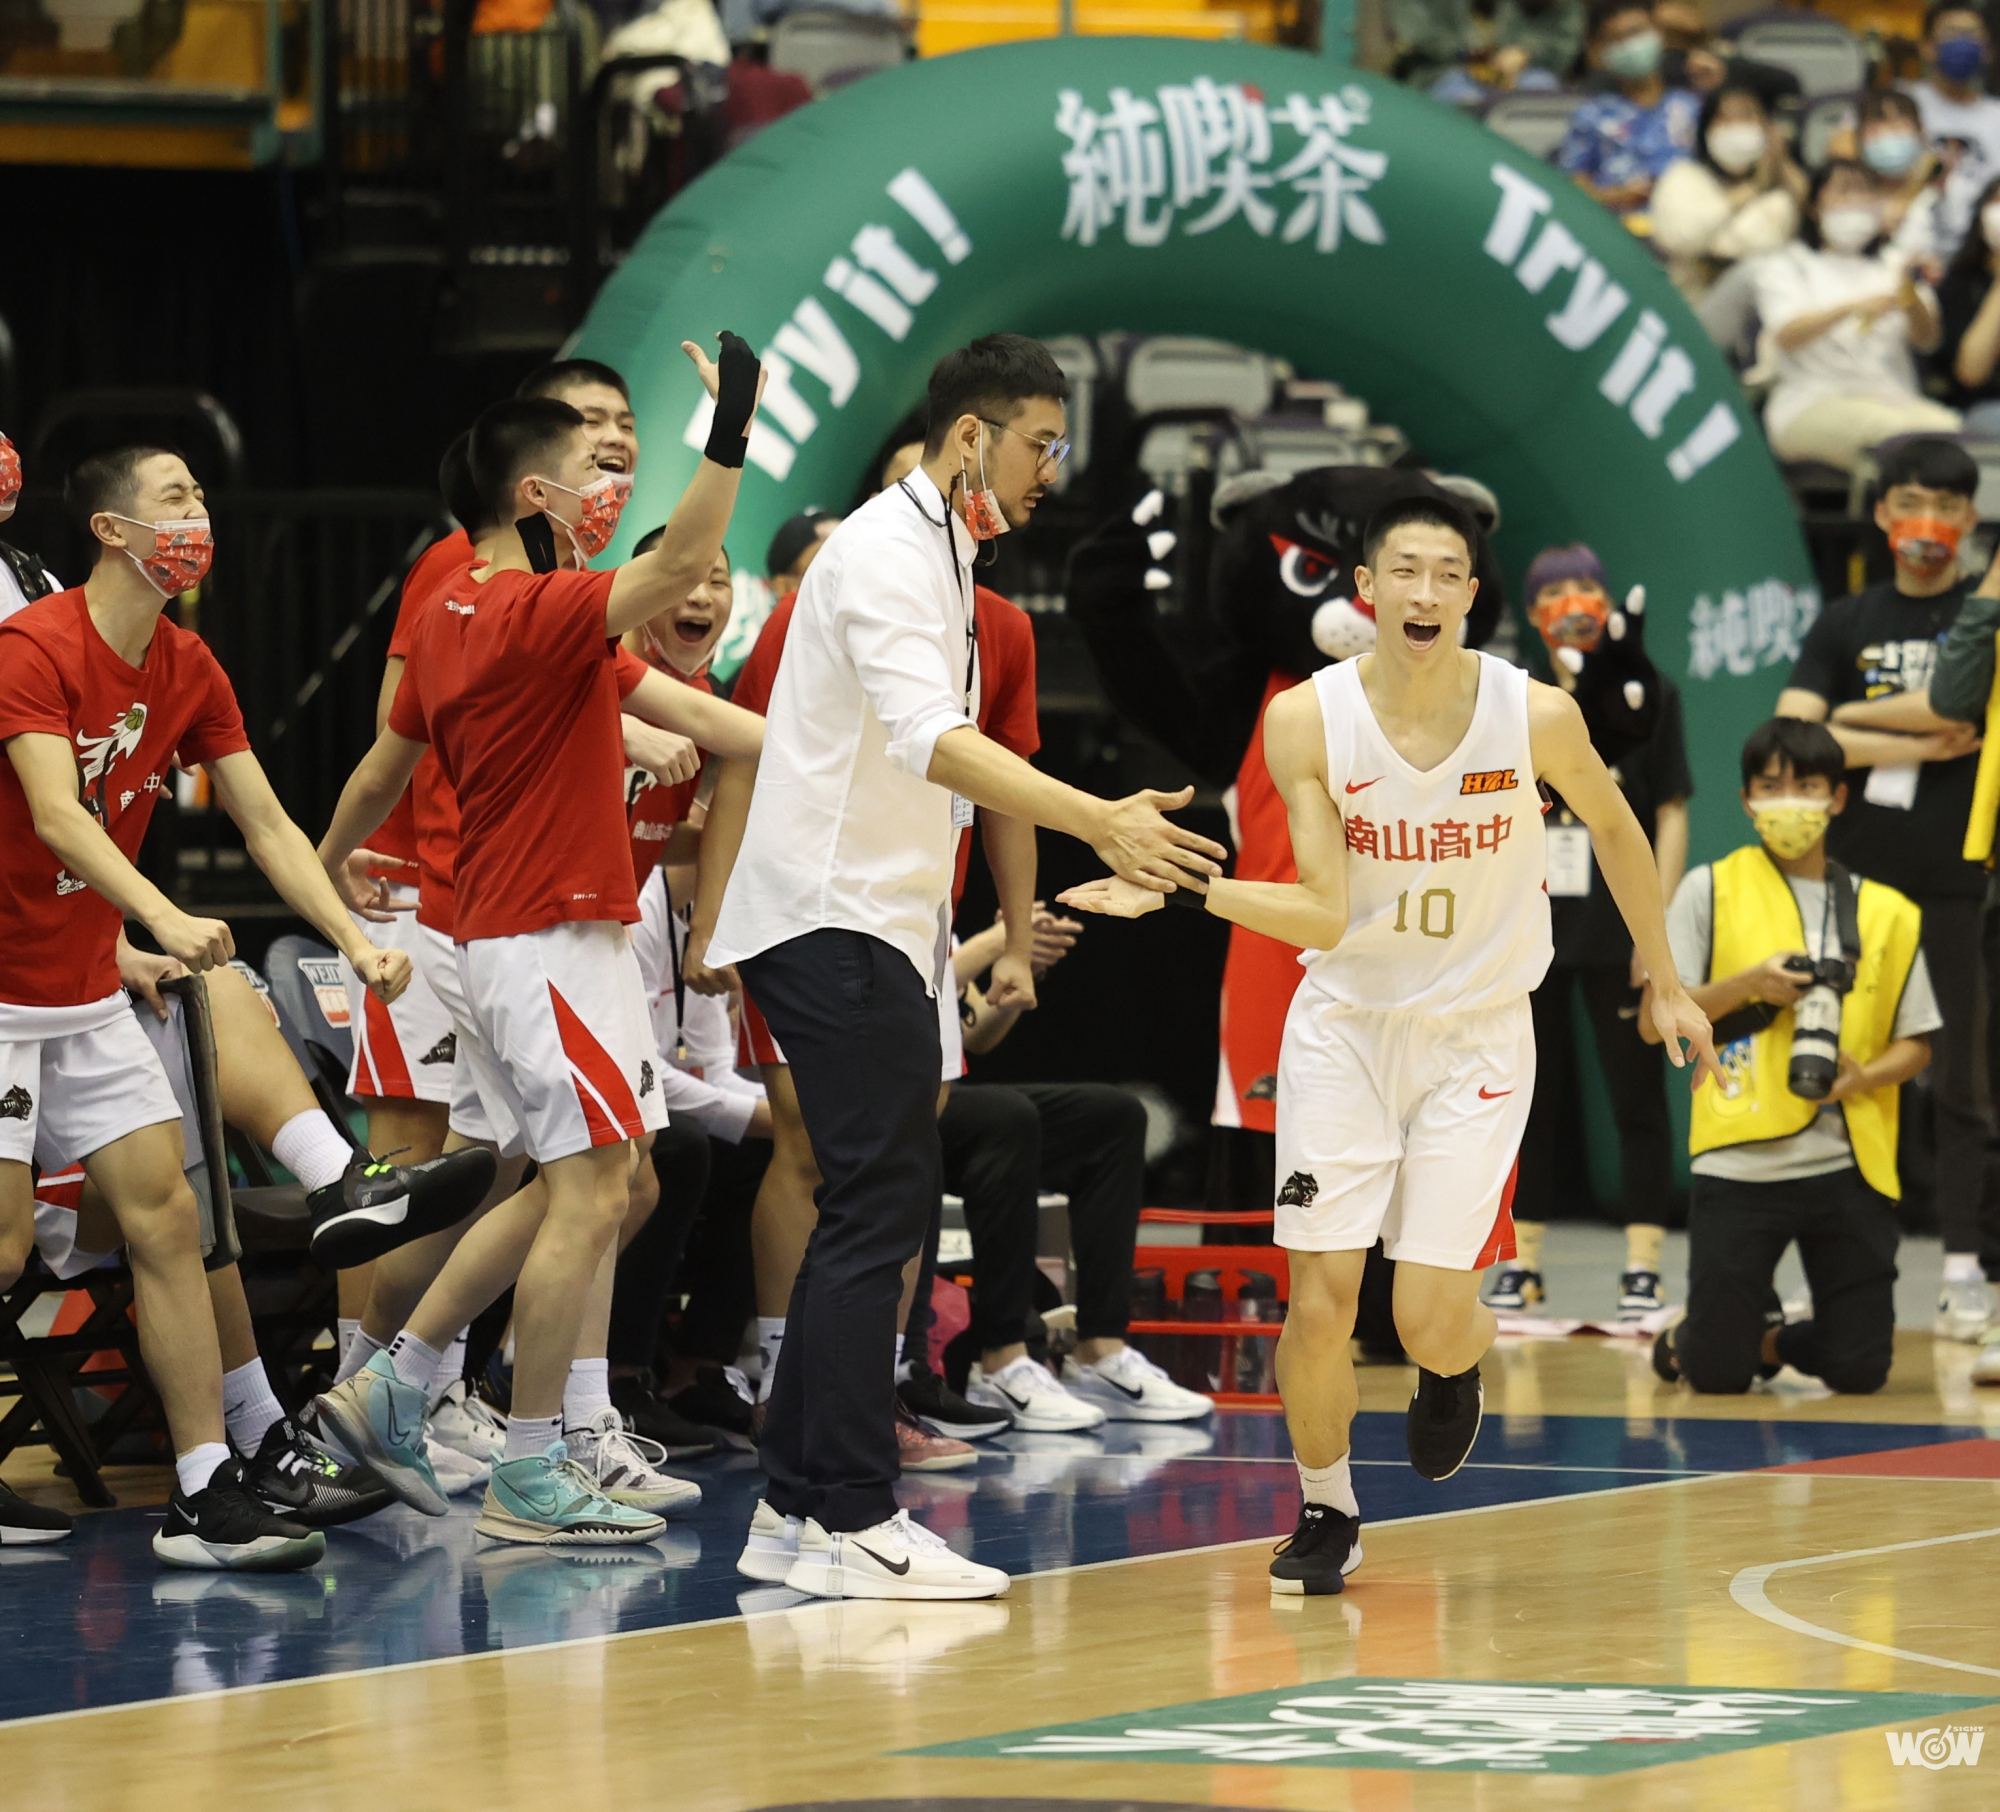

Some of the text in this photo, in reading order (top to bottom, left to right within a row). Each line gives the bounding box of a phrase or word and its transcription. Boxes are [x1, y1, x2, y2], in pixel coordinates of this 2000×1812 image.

[1054, 76, 1389, 252] 純喫茶
[1483, 161, 1631, 350] Try
[1344, 813, 1513, 863] 南山高中
[1392, 888, 1456, 939] 10
